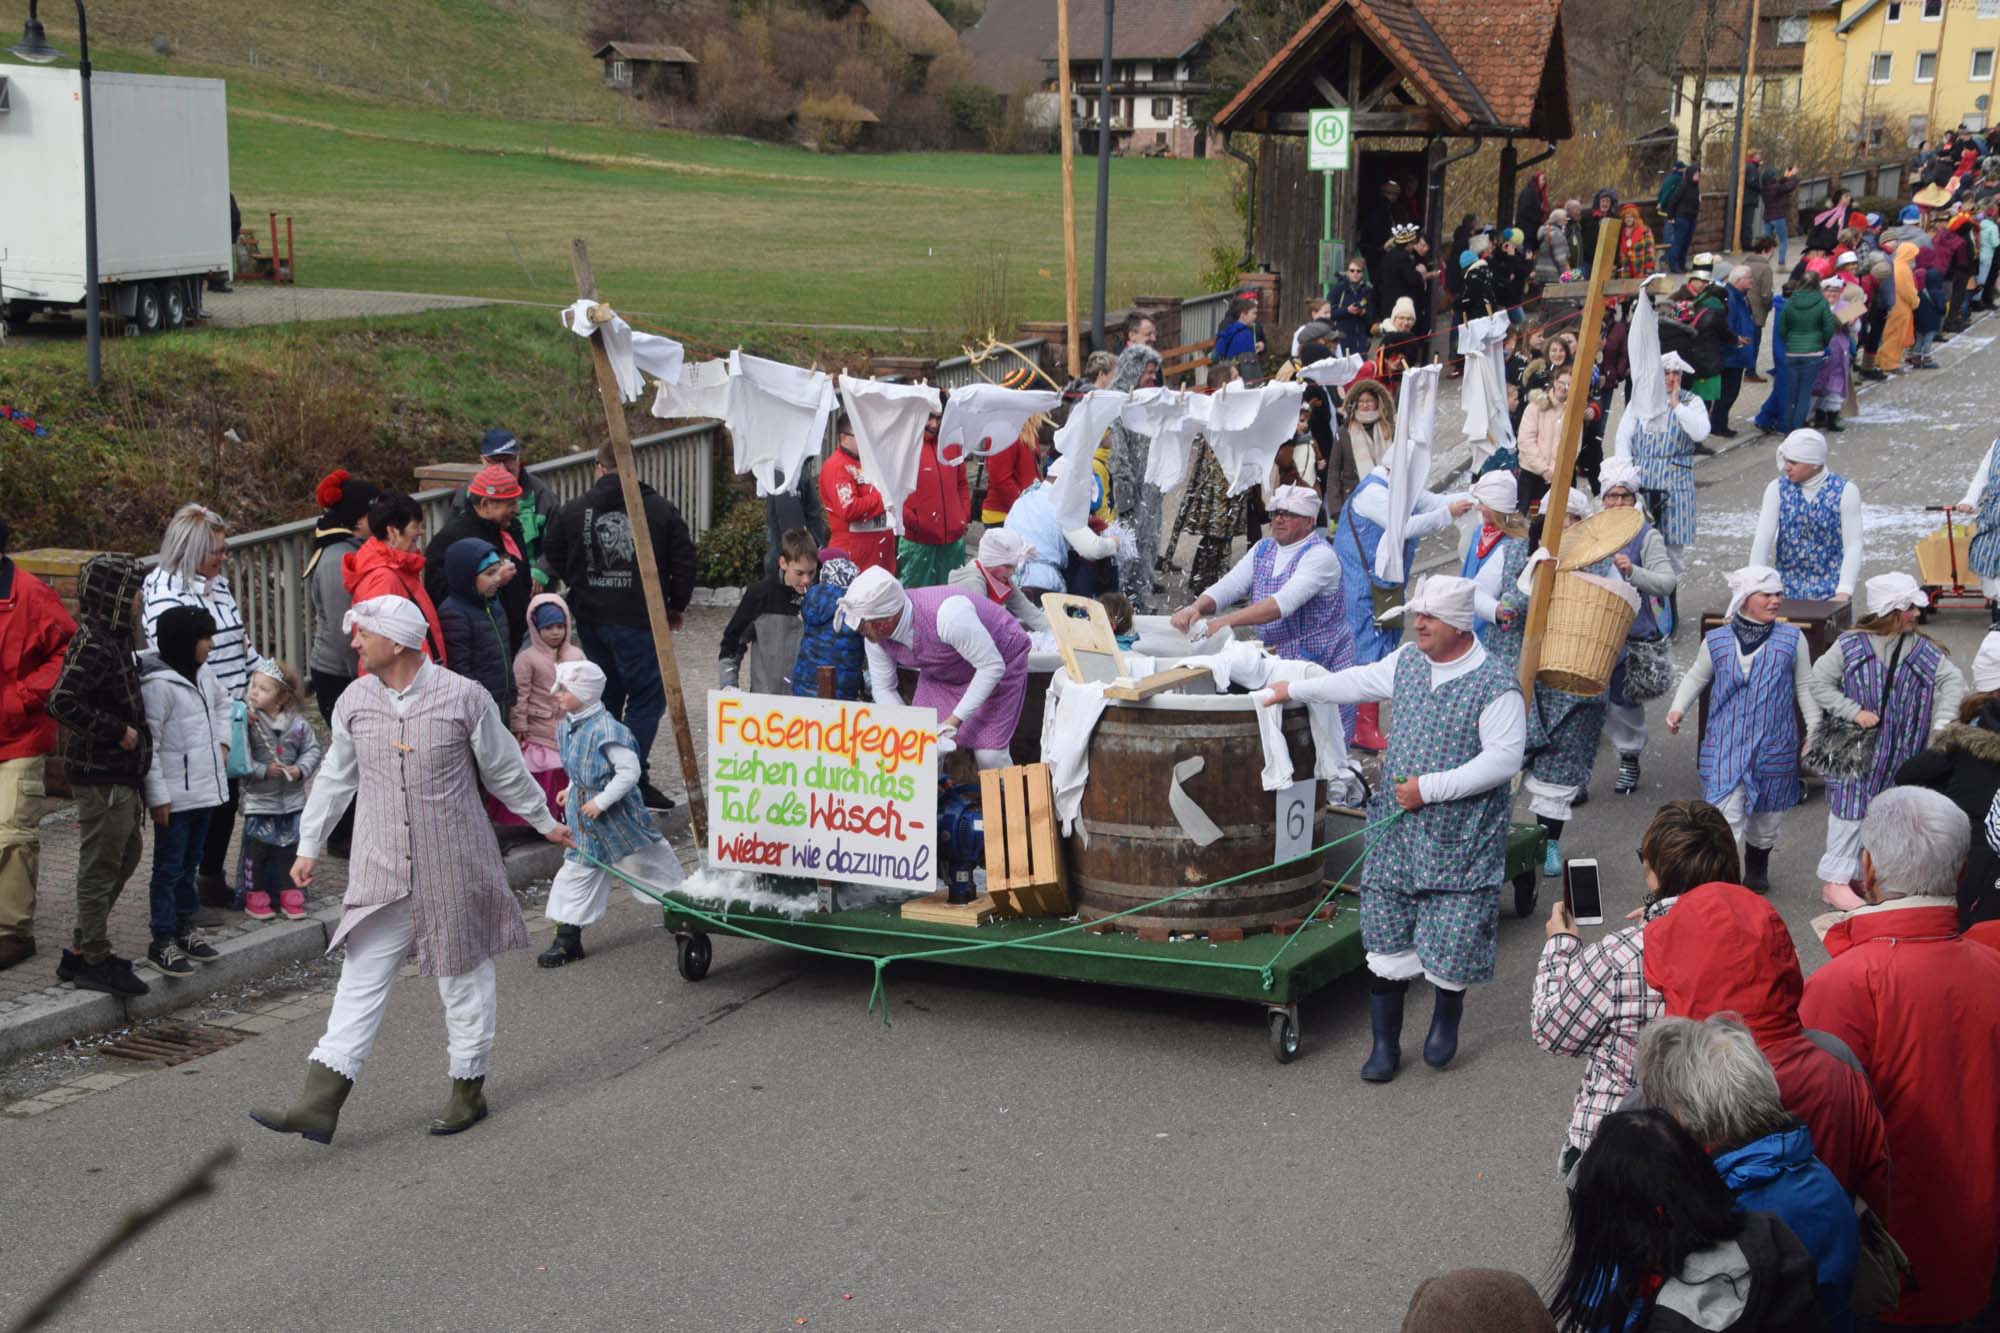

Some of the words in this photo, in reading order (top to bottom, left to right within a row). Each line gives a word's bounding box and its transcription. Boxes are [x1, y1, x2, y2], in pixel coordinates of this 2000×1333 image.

[1322, 122, 1337, 140] H
[717, 700, 938, 773] Fasendfeger
[715, 750, 797, 786] ziehen
[715, 785, 760, 824] Tal
[766, 791, 807, 827] als
[1287, 800, 1305, 840] 6
[793, 839, 821, 867] wie
[826, 837, 929, 881] dazumal
